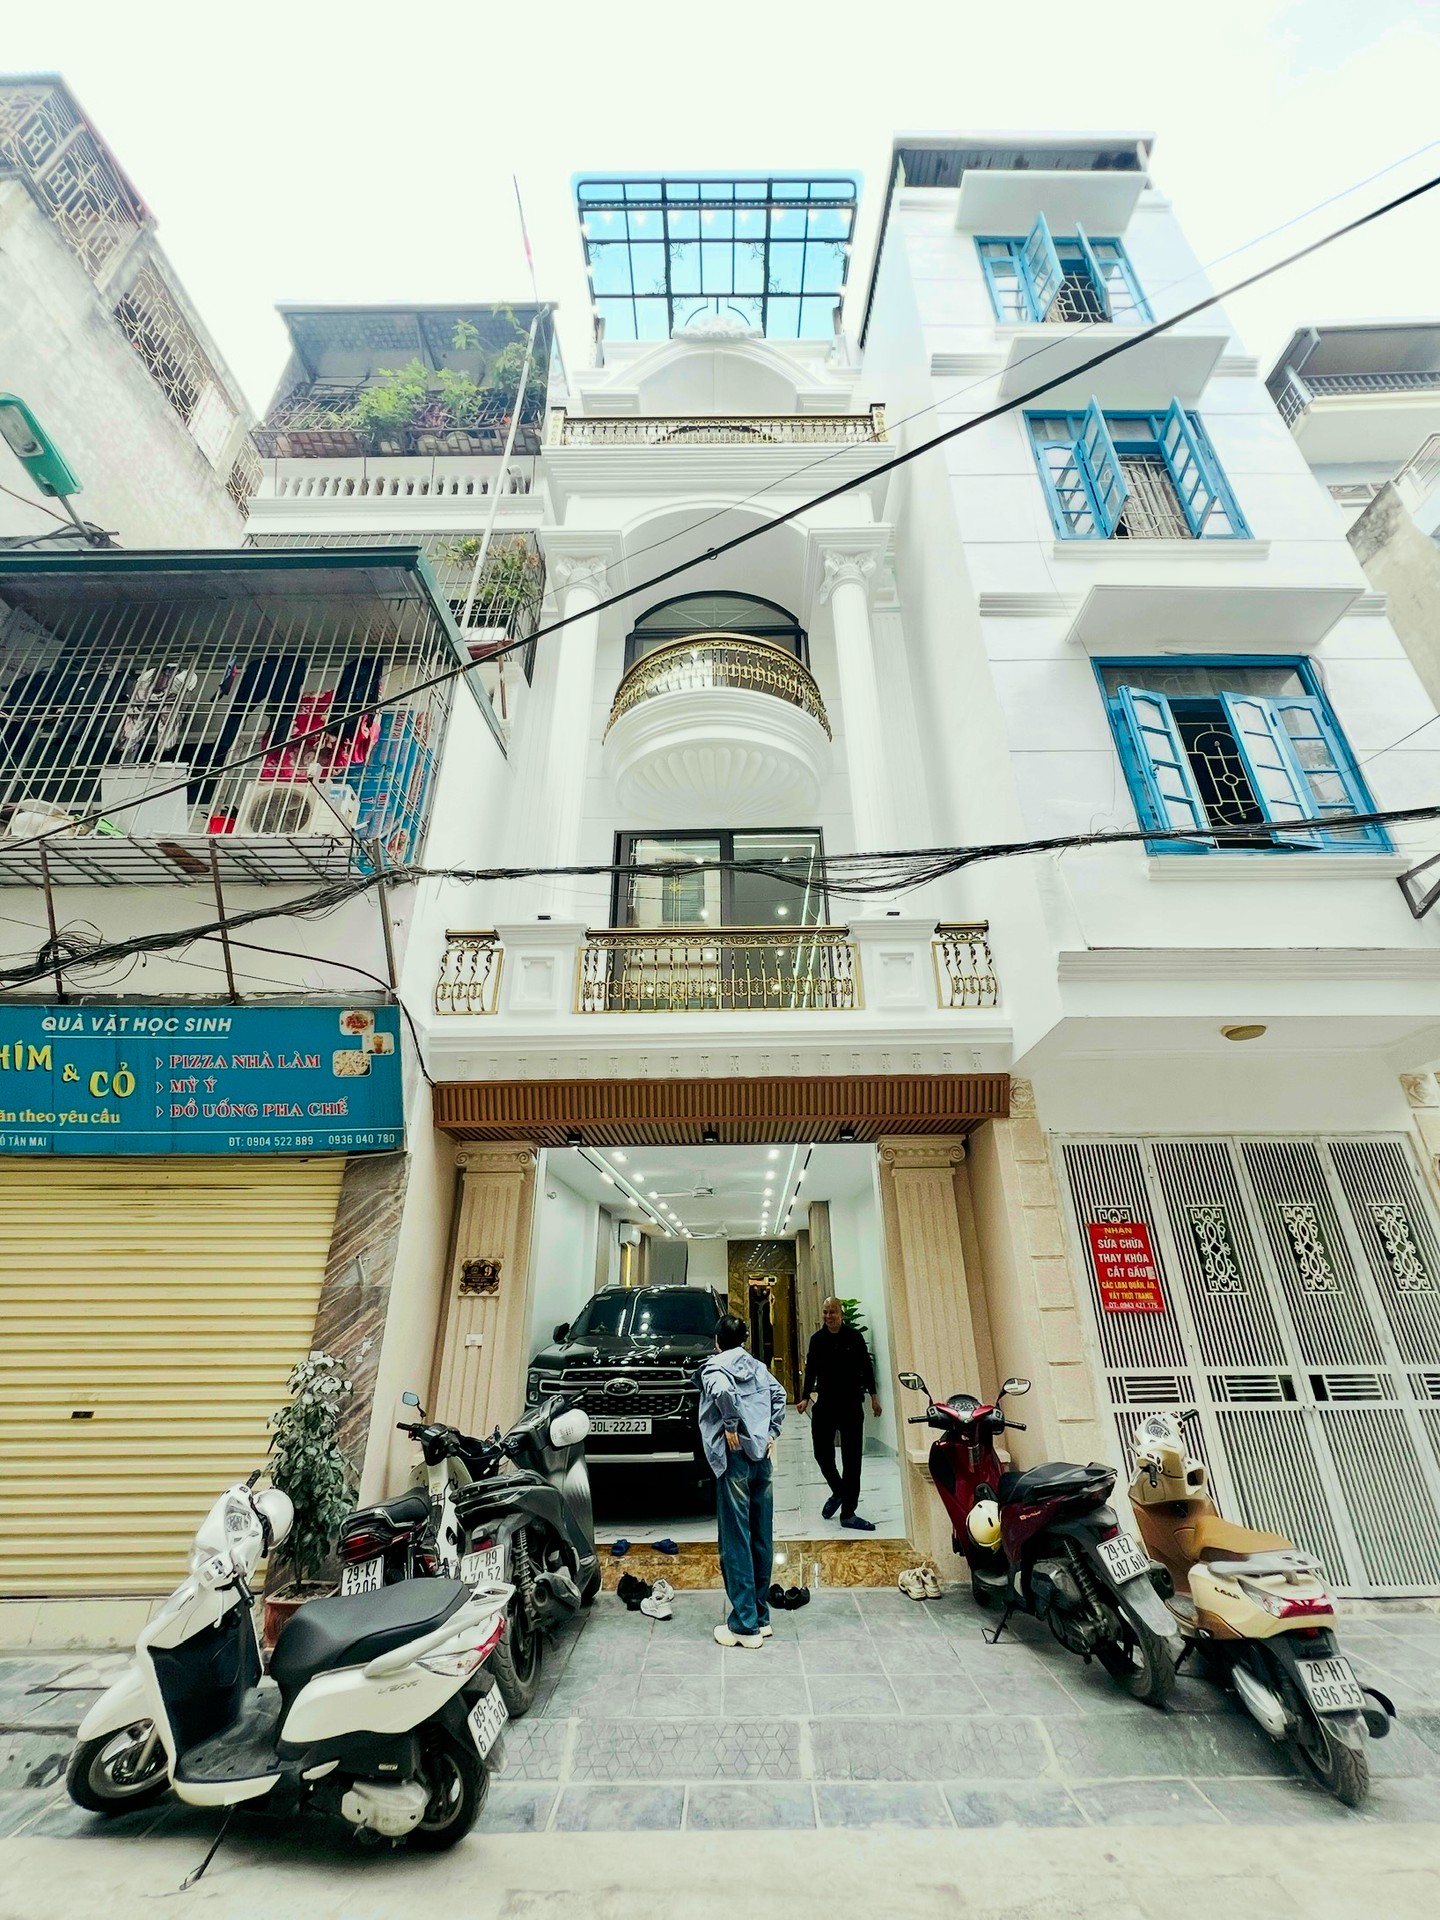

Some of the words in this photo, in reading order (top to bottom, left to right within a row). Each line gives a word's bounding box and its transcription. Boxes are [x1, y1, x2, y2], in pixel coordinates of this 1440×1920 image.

[41, 1013, 84, 1031] QUÀ
[91, 1013, 130, 1036] VẶT
[133, 1017, 180, 1036] HỌC
[184, 1017, 232, 1032] SINH
[169, 1055, 229, 1069] PIZZA
[231, 1051, 275, 1069] NHÀ
[277, 1051, 321, 1069] LÀM
[62, 1063, 80, 1082] &
[89, 1061, 137, 1098] CỎ
[203, 1075, 218, 1093] Ý
[202, 1097, 258, 1118] UỐNG
[262, 1103, 304, 1117] PHA
[307, 1096, 349, 1116] CHẾ
[19, 1108, 56, 1123] theo
[58, 1110, 89, 1126] yêu
[91, 1108, 121, 1123] cầu
[29, 1136, 47, 1146] MAI
[247, 1136, 271, 1147] 0904
[274, 1136, 292, 1147] 522
[295, 1135, 314, 1146] 889
[328, 1134, 353, 1145] 0936
[356, 1134, 374, 1144] 040
[377, 1133, 395, 1143] 780
[1098, 1253, 1122, 1263] THAY
[484, 1266, 493, 1276] 9
[591, 1421, 647, 1432] 30L-222.23
